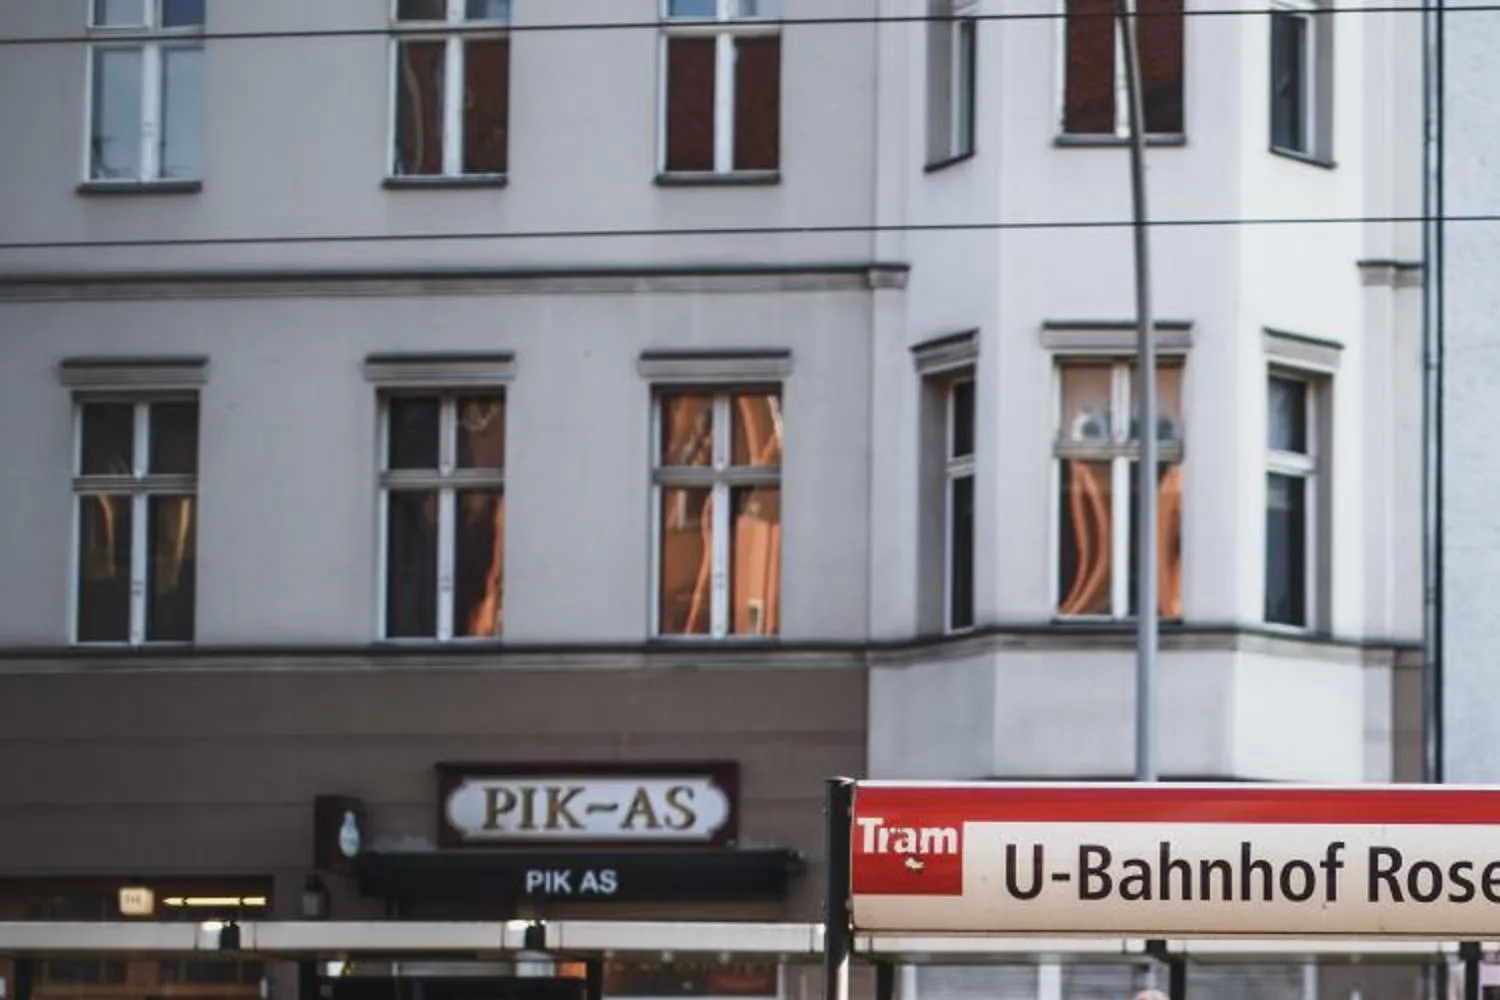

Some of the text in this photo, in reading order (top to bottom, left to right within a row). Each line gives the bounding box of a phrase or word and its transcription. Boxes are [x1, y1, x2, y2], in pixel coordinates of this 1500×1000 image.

[856, 816, 958, 856] Tram
[525, 869, 619, 894] PIK AS
[1004, 840, 1346, 902] U-Bahnhof
